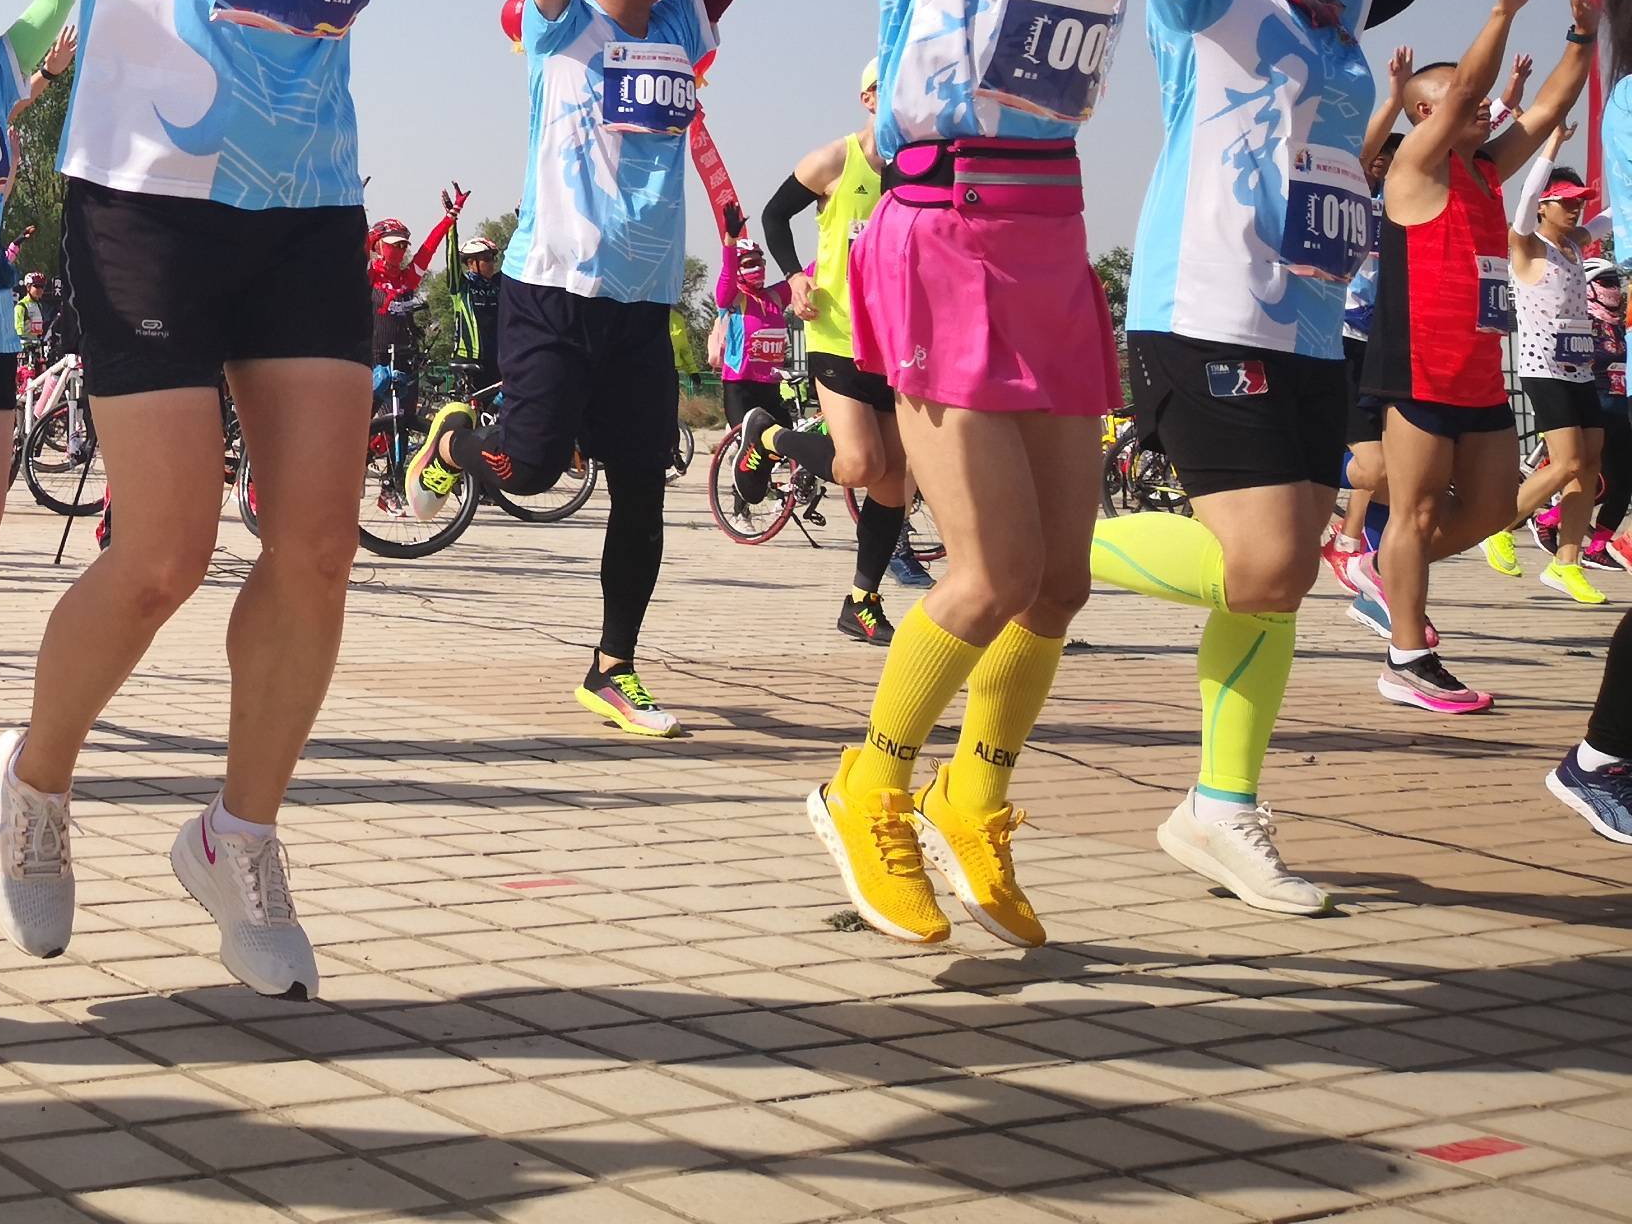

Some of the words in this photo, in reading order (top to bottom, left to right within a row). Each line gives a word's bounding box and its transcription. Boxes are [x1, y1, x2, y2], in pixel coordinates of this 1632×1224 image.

[1047, 18, 1109, 76] 00
[634, 73, 696, 111] 0069
[1322, 194, 1367, 247] 0119
